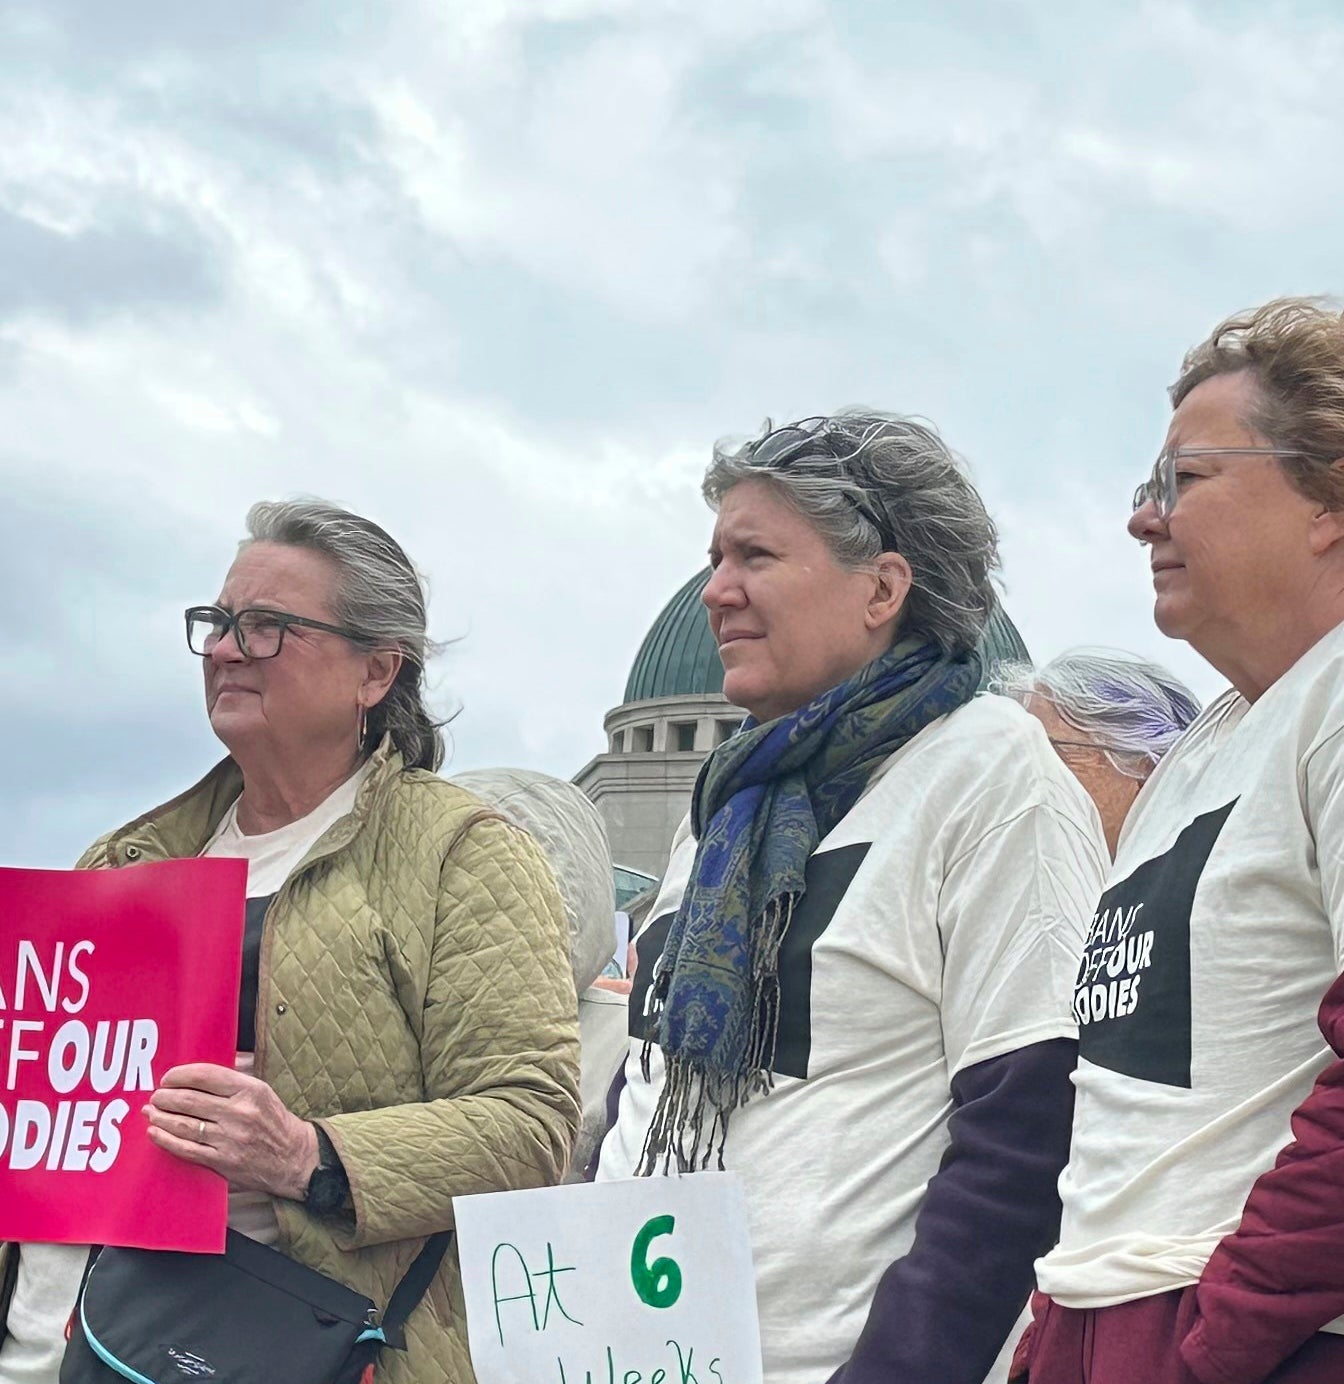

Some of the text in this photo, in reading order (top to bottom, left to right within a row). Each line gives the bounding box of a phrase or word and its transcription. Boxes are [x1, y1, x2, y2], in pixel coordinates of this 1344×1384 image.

[1072, 974, 1141, 1026] ODIES
[491, 1214, 683, 1347] At 6
